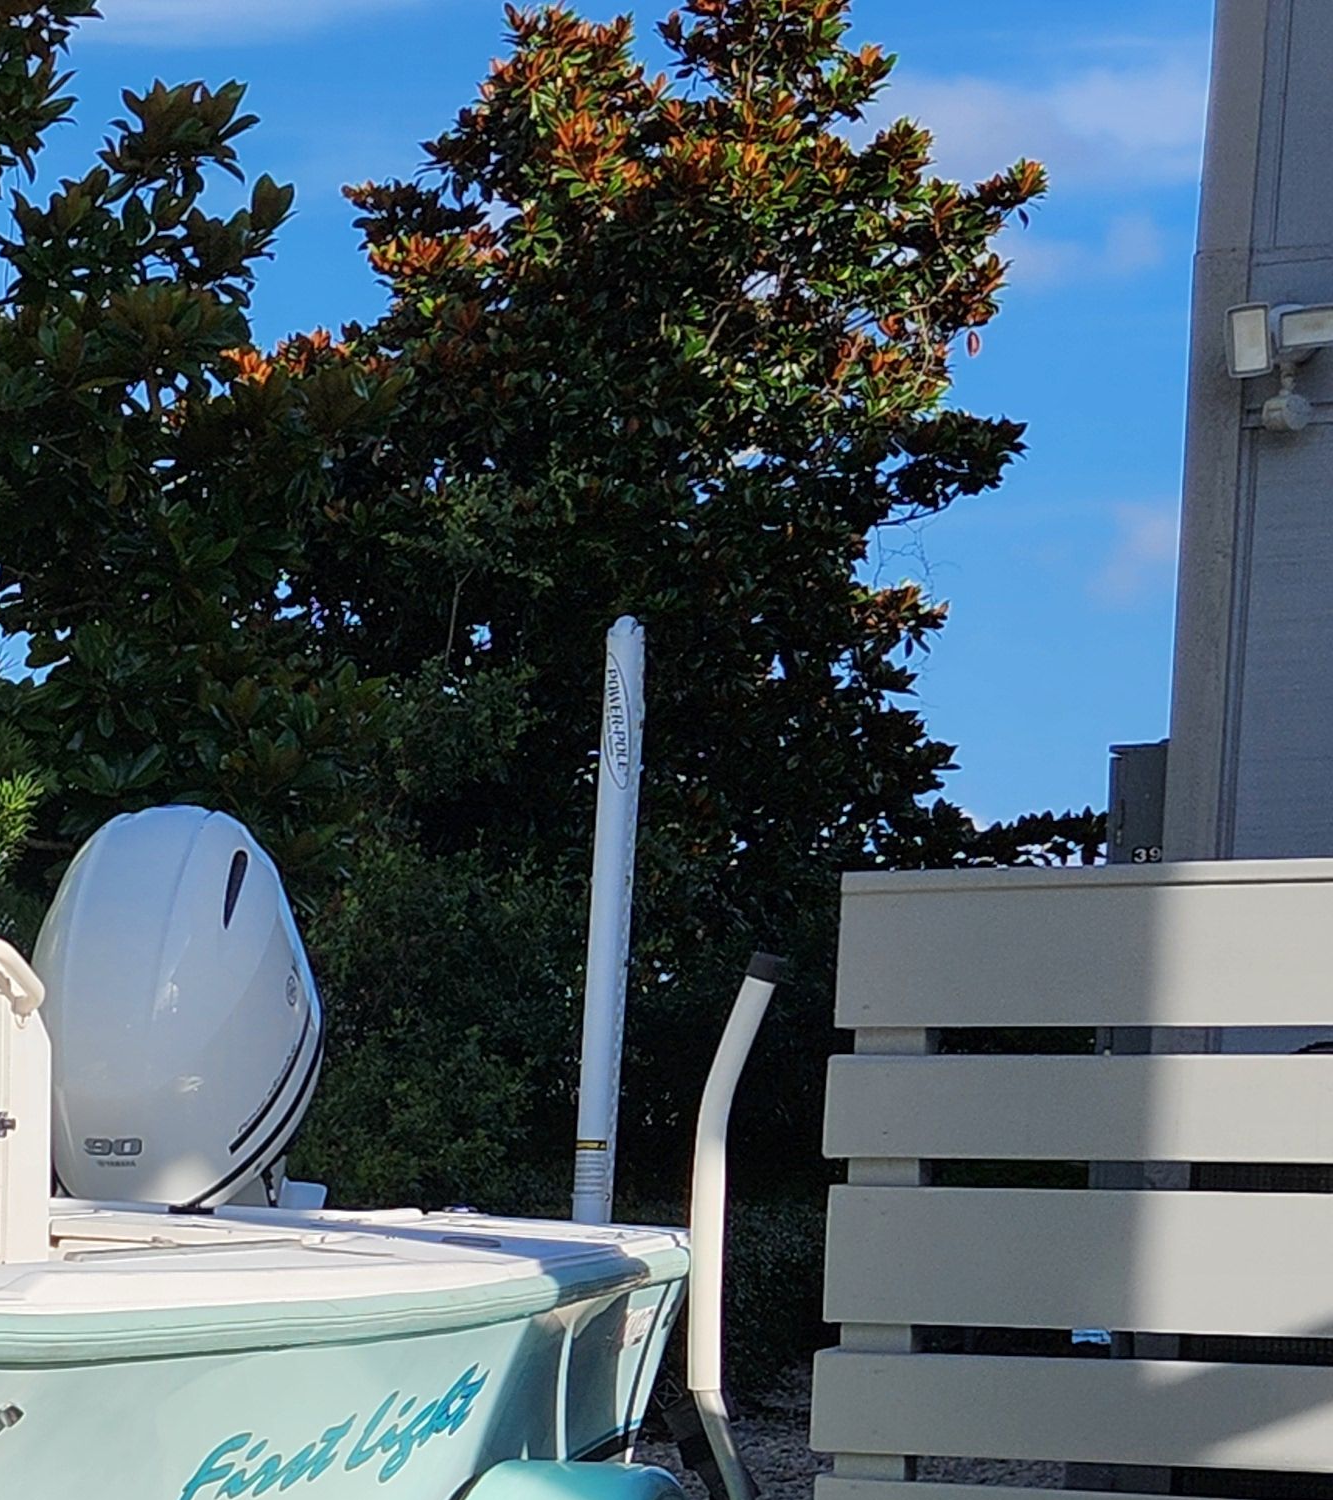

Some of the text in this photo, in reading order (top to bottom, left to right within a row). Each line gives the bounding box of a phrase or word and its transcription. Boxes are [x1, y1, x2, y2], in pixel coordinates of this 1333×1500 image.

[1133, 847, 1161, 863] 39
[83, 1138, 143, 1156] 90
[344, 1362, 491, 1484] Light
